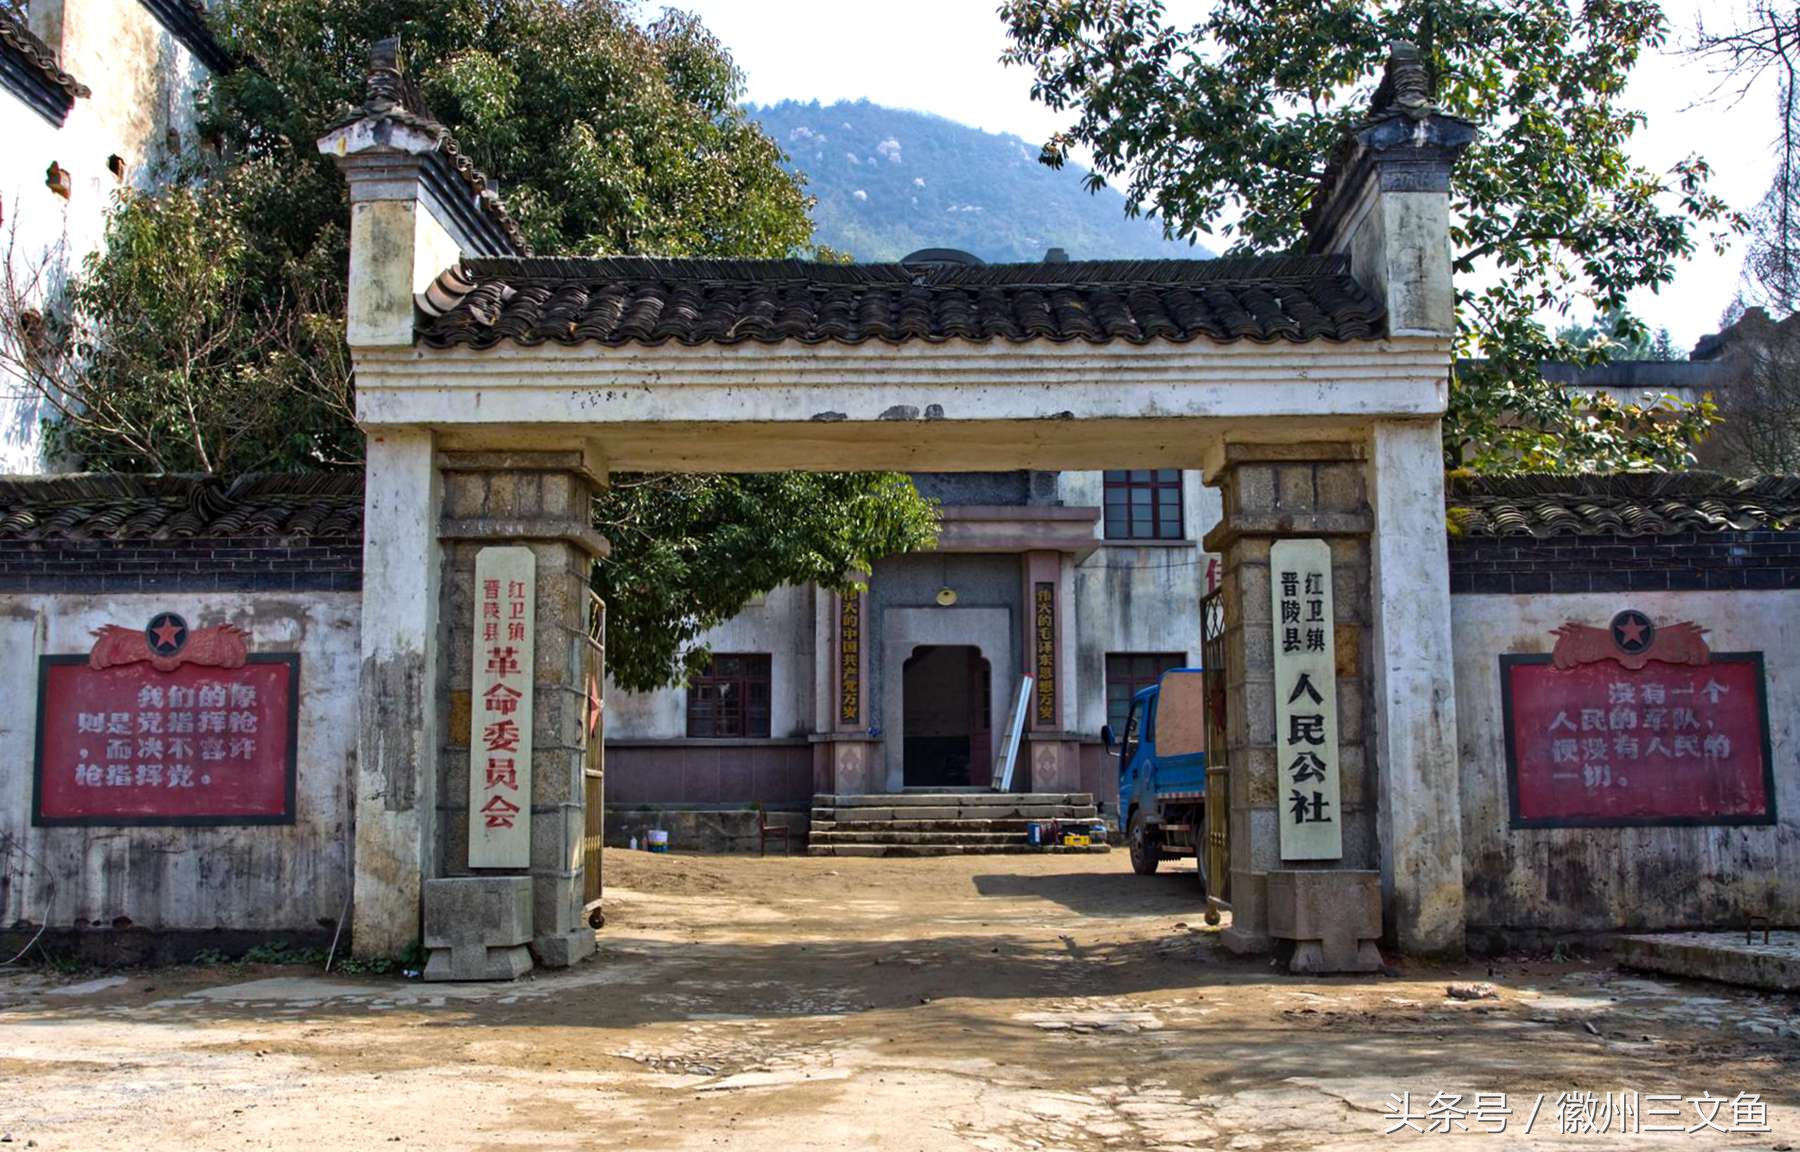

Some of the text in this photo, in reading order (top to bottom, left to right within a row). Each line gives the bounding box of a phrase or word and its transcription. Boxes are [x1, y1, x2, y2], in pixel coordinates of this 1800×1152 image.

[483, 579, 501, 641] 晋陵县
[507, 580, 526, 642] 红卫镇
[1281, 572, 1302, 653] 晋陵县
[1304, 572, 1326, 652] 红卫镇
[78, 711, 258, 734] 则是党指挥枪
[137, 684, 257, 708] 我们的原
[1608, 680, 1729, 704] 没有一个
[480, 647, 523, 830] 革命委员会
[1287, 673, 1333, 824] 人民公社
[1552, 734, 1731, 762] 便没有人民的
